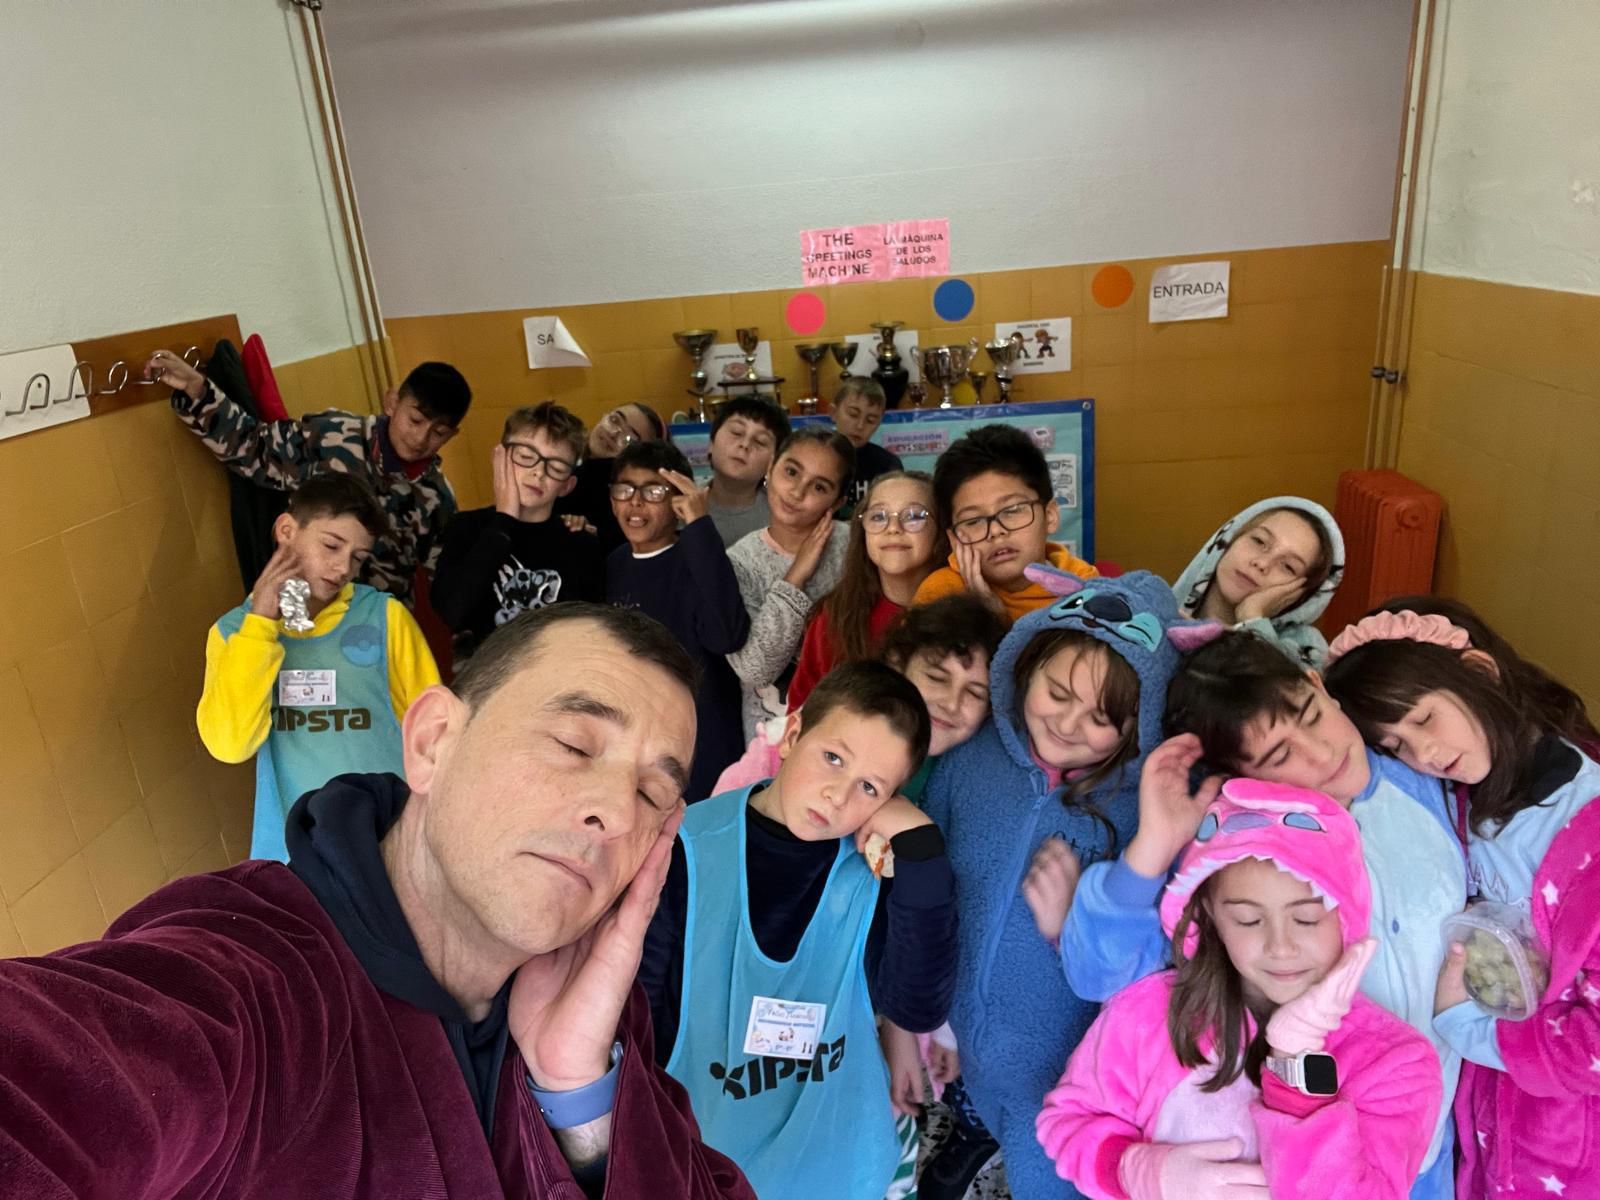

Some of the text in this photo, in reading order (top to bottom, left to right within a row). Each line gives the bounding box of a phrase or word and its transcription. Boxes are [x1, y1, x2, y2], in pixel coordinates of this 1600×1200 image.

[823, 233, 854, 247] THE
[884, 237, 896, 246] LA
[914, 246, 931, 254] LOS
[1153, 281, 1225, 299] ENTRADA
